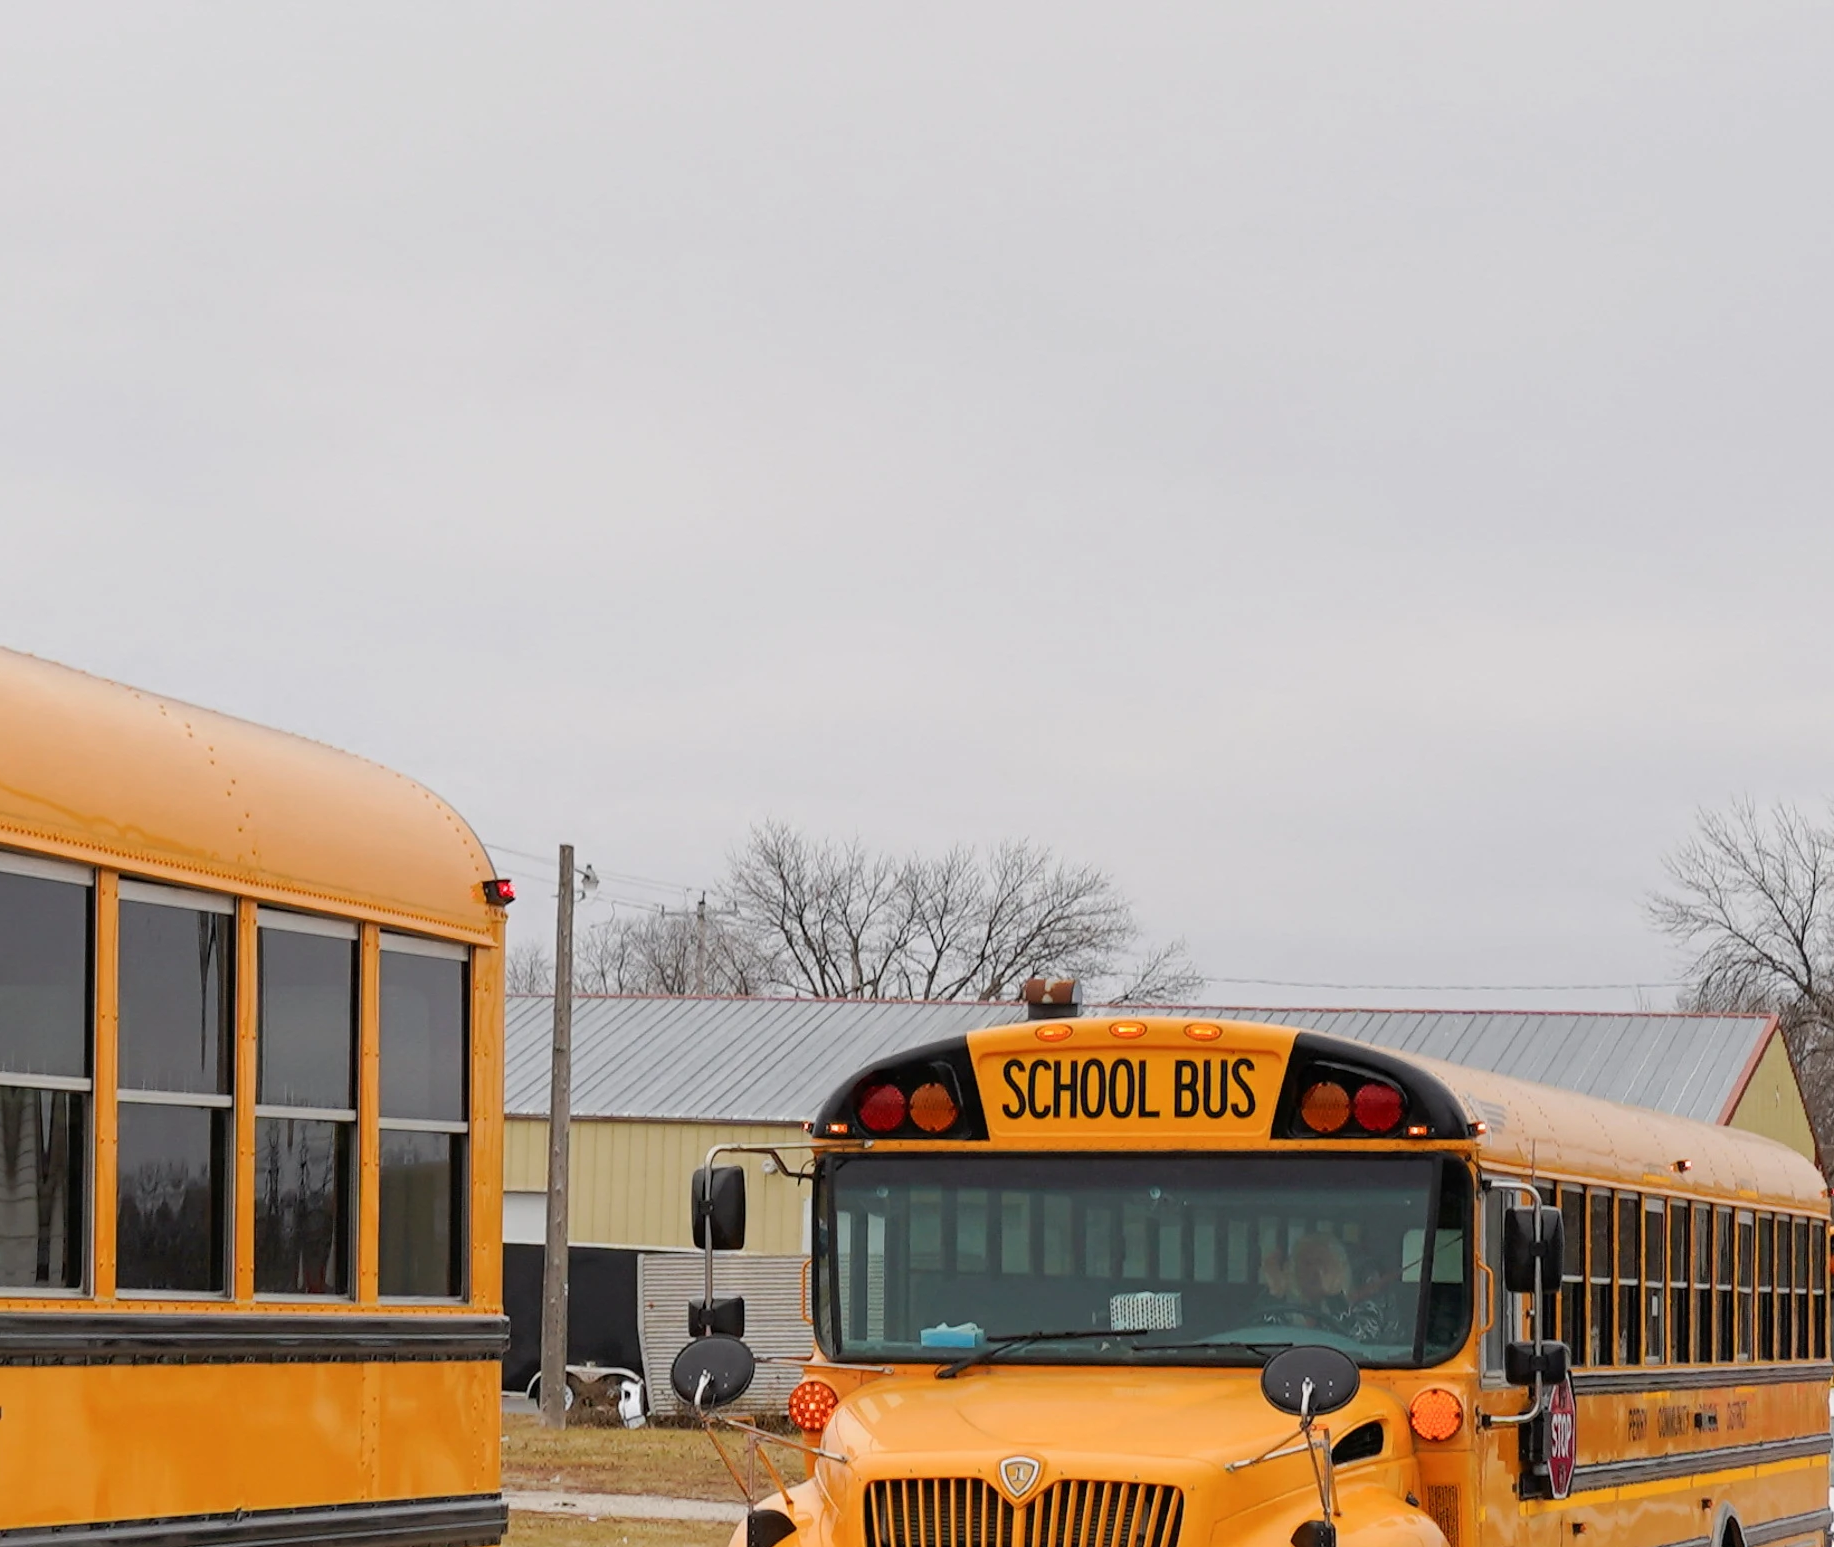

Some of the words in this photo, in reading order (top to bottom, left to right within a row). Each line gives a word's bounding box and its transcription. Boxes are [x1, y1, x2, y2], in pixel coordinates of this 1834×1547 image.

[1002, 1058, 1160, 1119] SCHOOL
[1174, 1058, 1256, 1119] BUS
[1551, 1413, 1572, 1458] STOP
